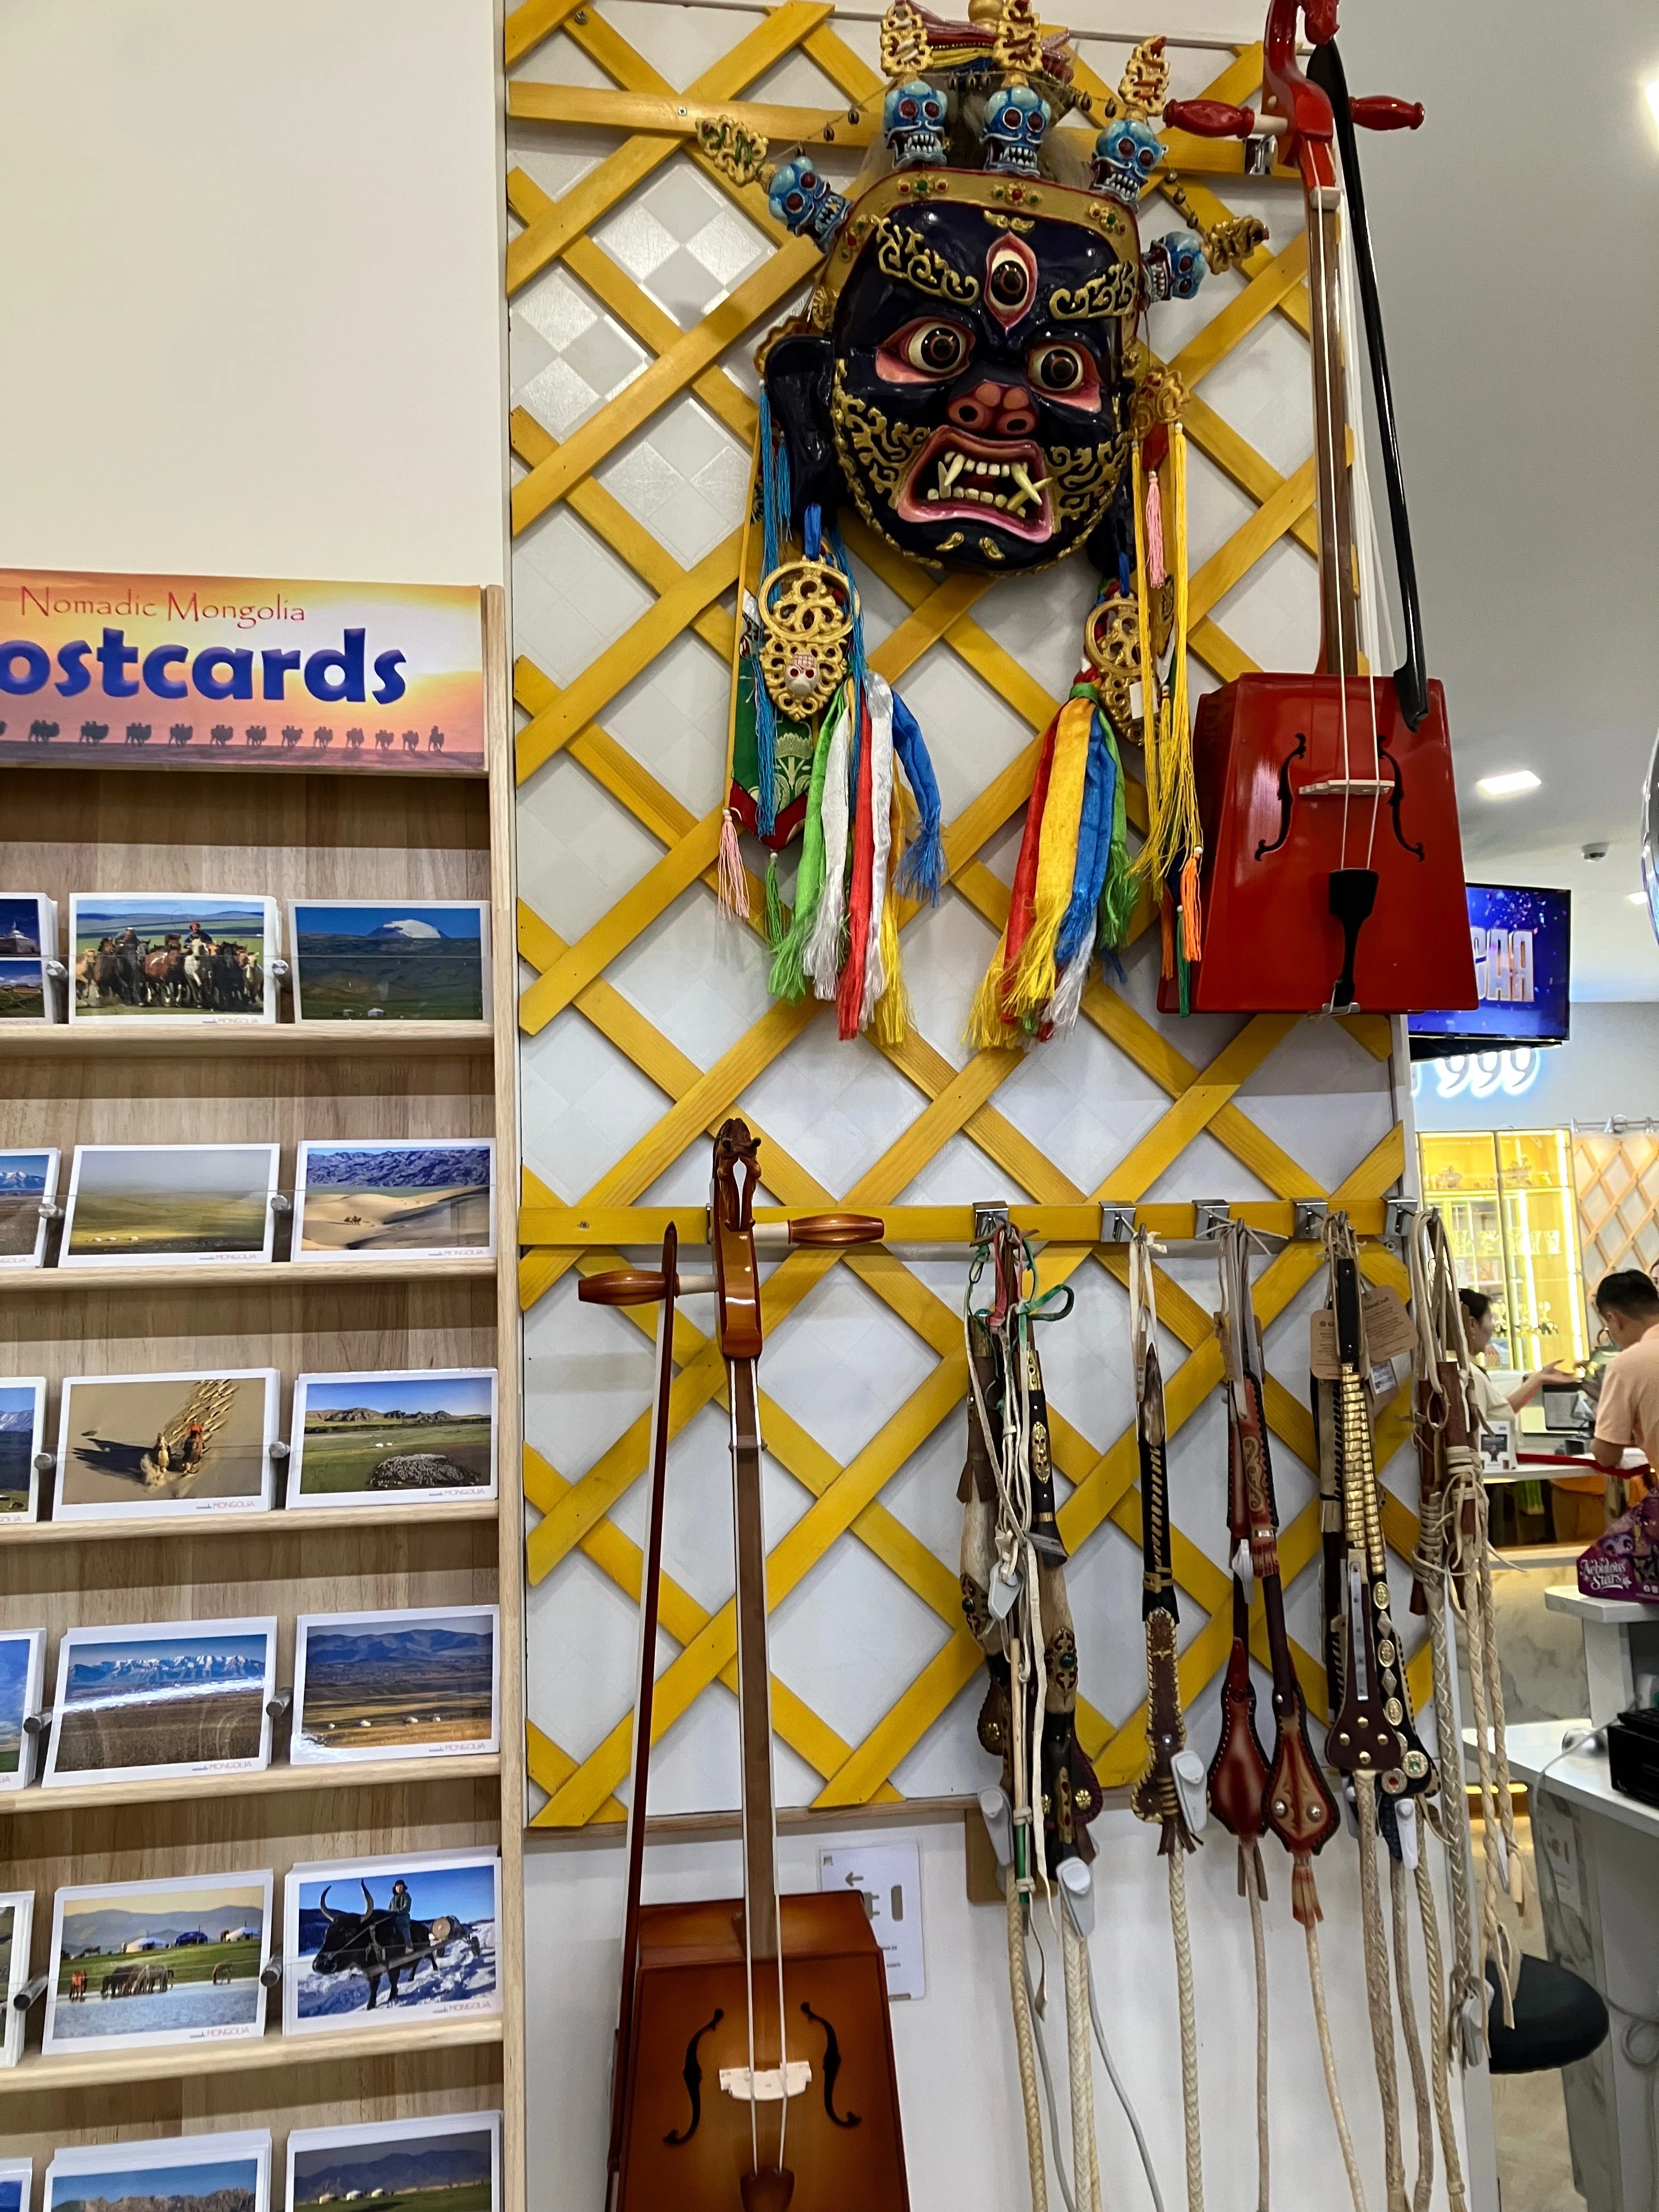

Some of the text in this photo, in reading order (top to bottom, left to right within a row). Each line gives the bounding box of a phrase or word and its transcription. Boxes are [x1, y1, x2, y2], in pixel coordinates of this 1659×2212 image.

[21, 585, 305, 629] Nomadic Mongolia
[0, 627, 407, 705] ostcards
[444, 1487, 485, 1496] MONGOLIA
[213, 1500, 255, 1509] MONGOLIA
[209, 1760, 252, 1770] MONGOLIA
[206, 2025, 250, 2036] MONGOLIA
